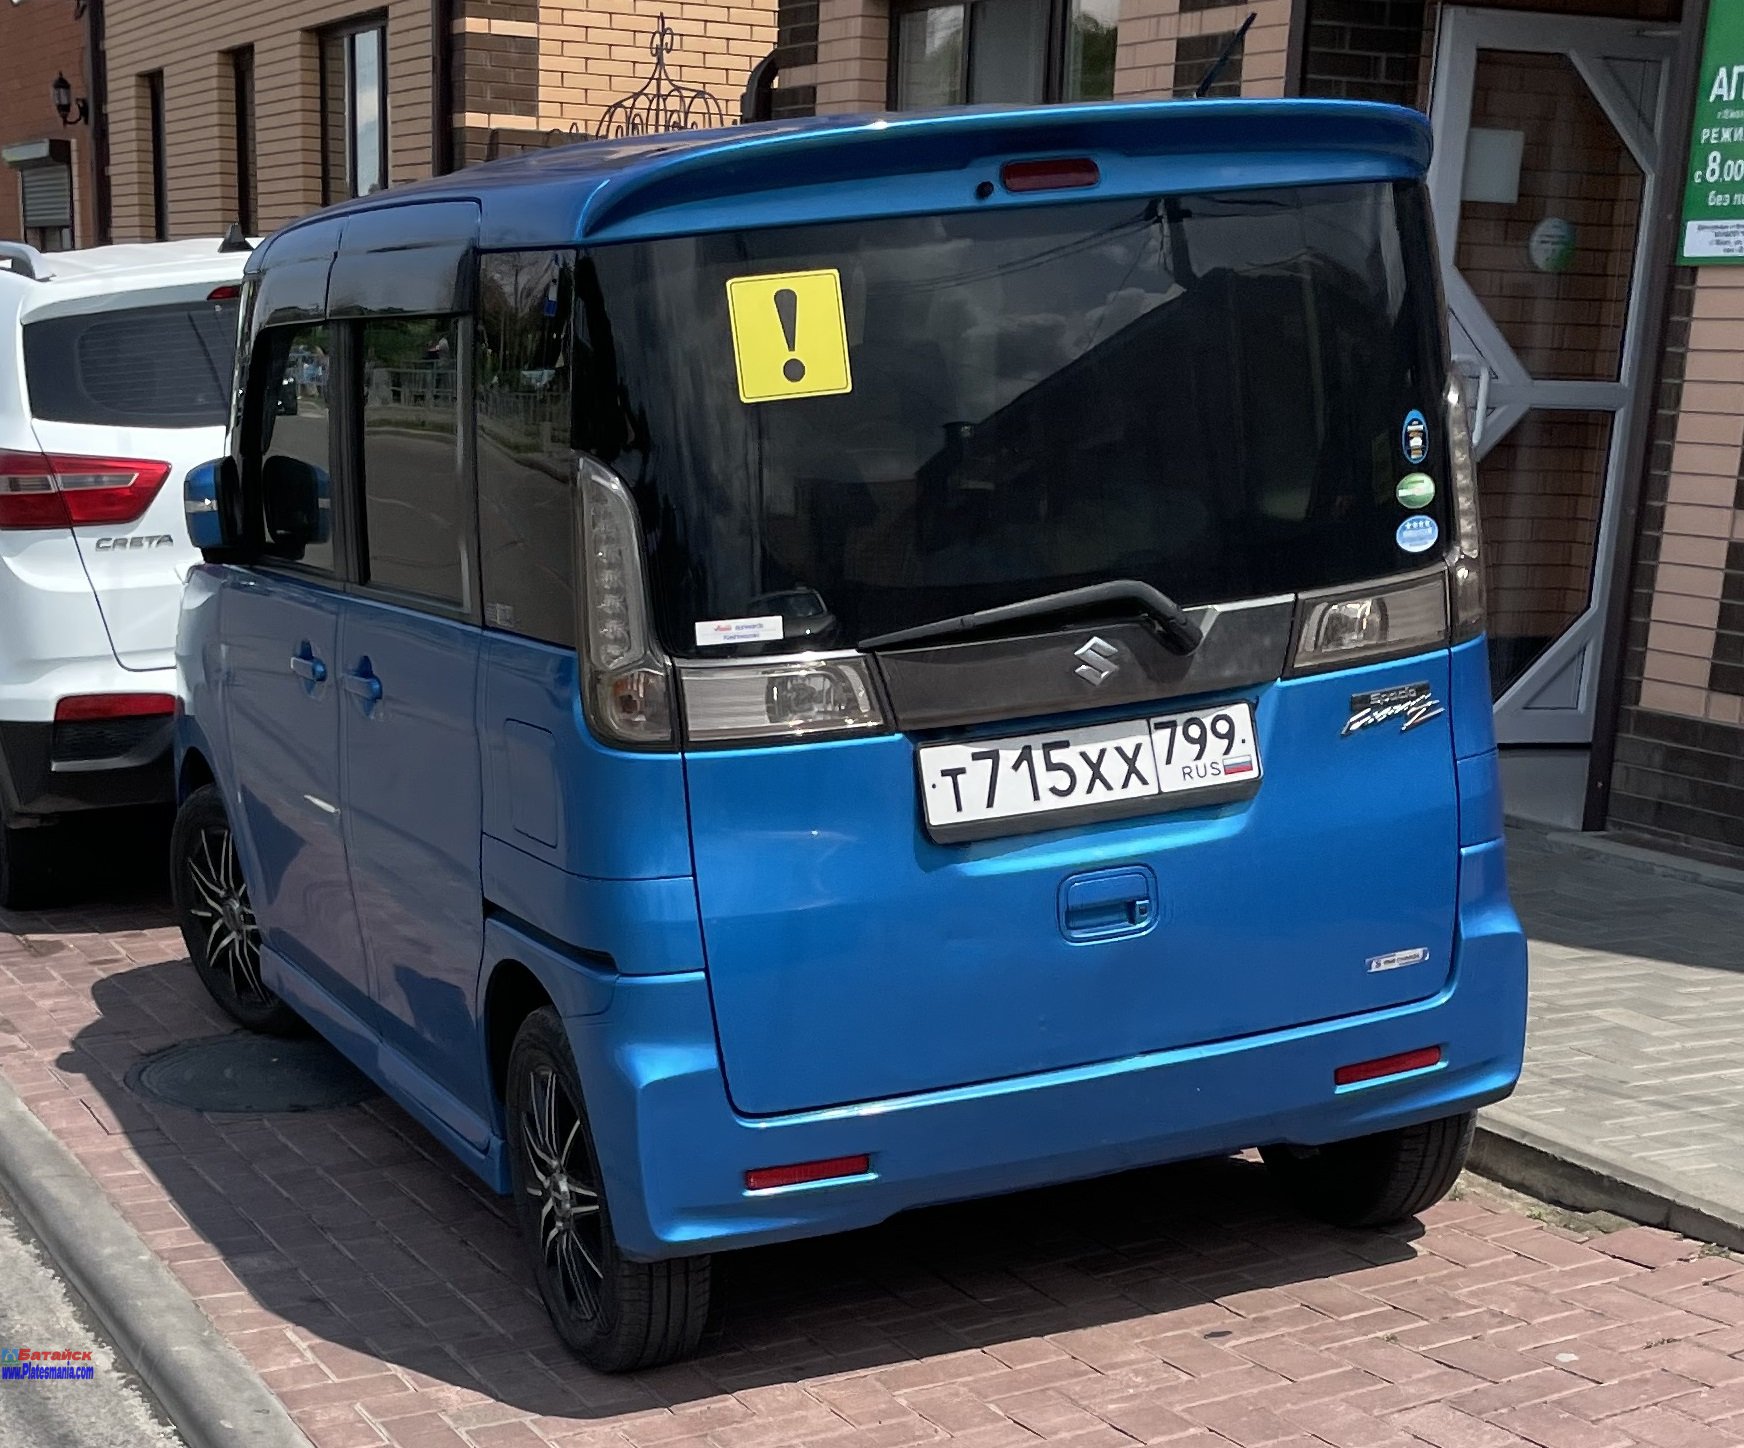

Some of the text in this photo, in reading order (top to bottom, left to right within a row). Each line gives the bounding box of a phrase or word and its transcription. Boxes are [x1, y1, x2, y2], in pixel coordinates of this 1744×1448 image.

[1693, 170, 1703, 183] с
[1707, 190, 1731, 206] без
[95, 534, 174, 552] CRETA
[1154, 713, 1236, 766] 799
[940, 740, 1150, 812] Т715ХХ
[1181, 761, 1222, 782] RUS
